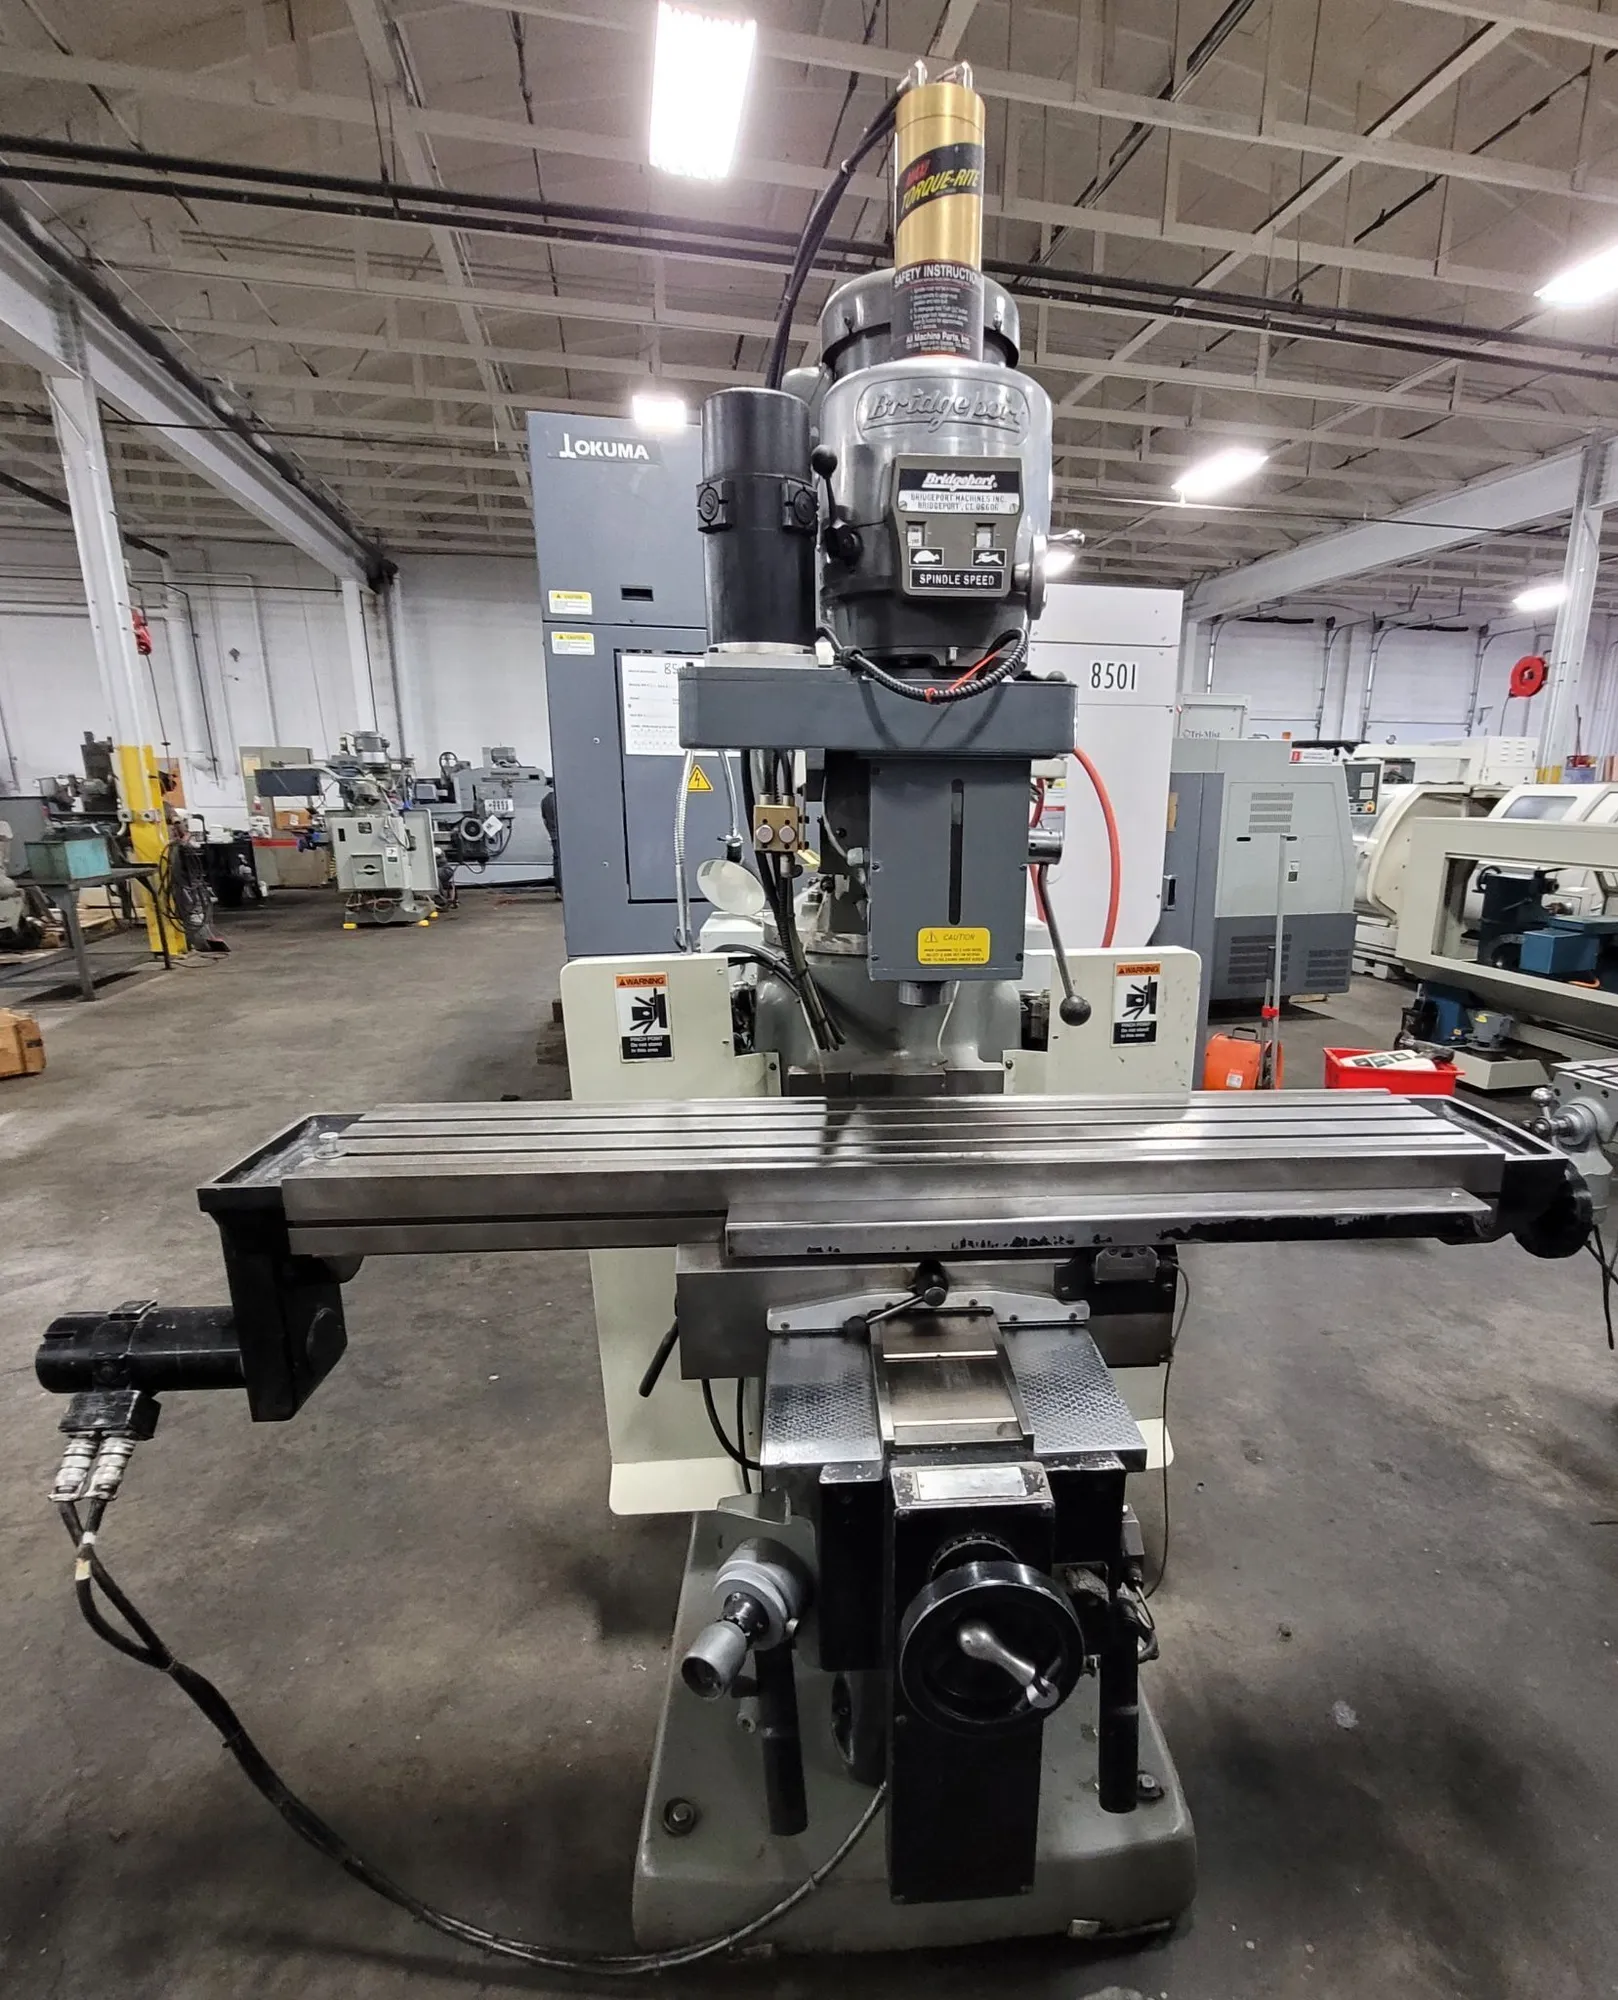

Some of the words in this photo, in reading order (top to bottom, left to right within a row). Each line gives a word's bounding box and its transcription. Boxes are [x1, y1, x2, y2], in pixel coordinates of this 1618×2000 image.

[900, 168, 980, 215] TORQUE-RITE
[894, 266, 921, 289] SAFETY
[923, 264, 979, 285] INSTRUCTIO
[574, 440, 650, 460] OKUMA
[910, 493, 953, 502] BRIDGEPORT
[955, 494, 991, 502] MACHINES
[919, 573, 960, 585] SPINDLE
[963, 573, 995, 586] SPEED
[943, 933, 976, 941] CAUTION
[1125, 966, 1160, 974] WARNING
[626, 977, 664, 986] WARNING
